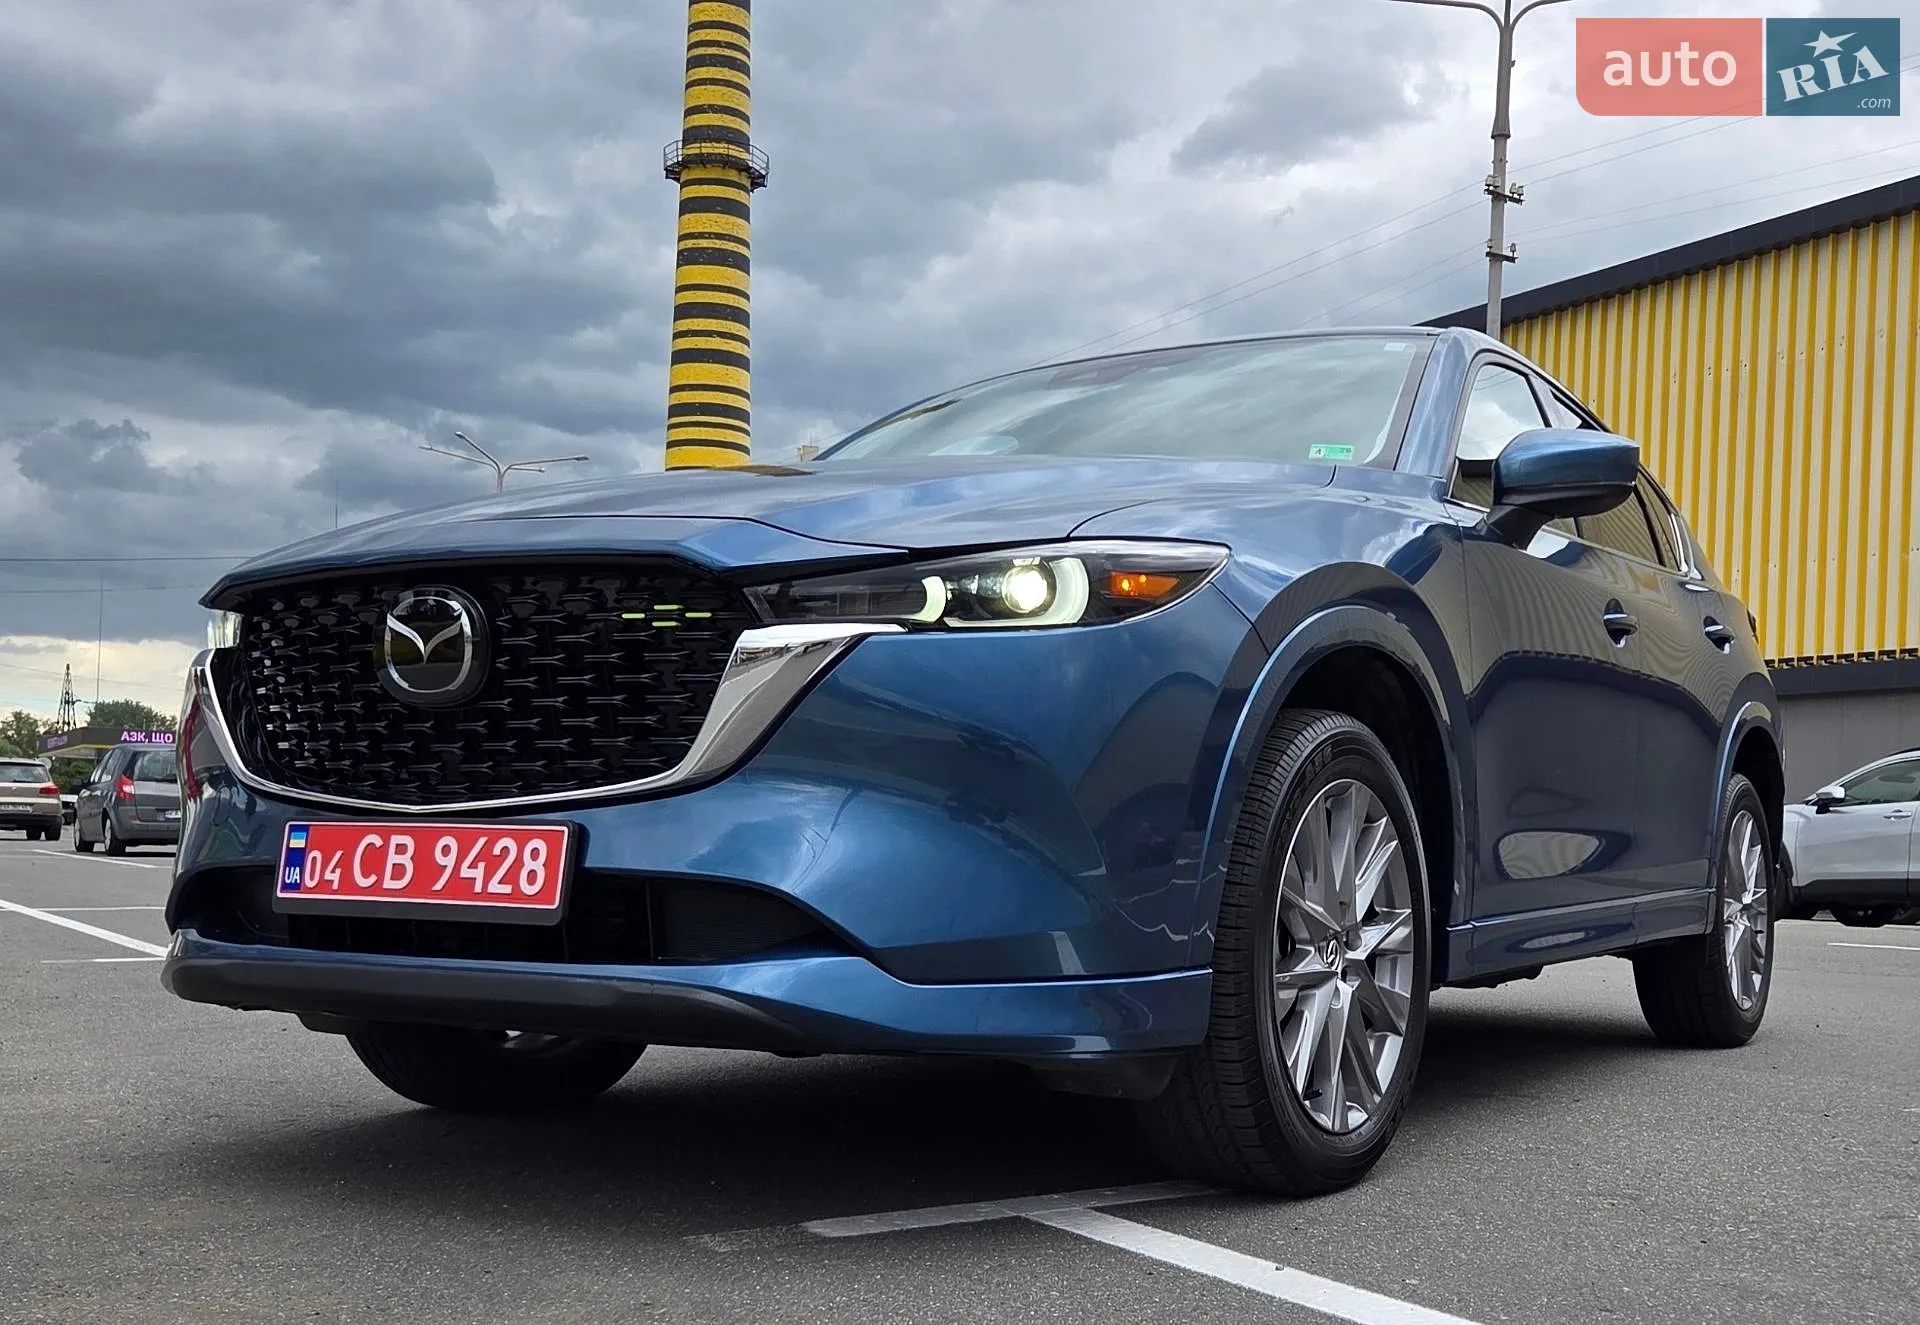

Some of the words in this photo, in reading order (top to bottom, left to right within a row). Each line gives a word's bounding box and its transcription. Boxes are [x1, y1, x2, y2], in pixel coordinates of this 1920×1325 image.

[285, 866, 300, 884] UA
[304, 850, 344, 890] 04
[353, 834, 415, 889] CB
[432, 835, 548, 895] 9428
